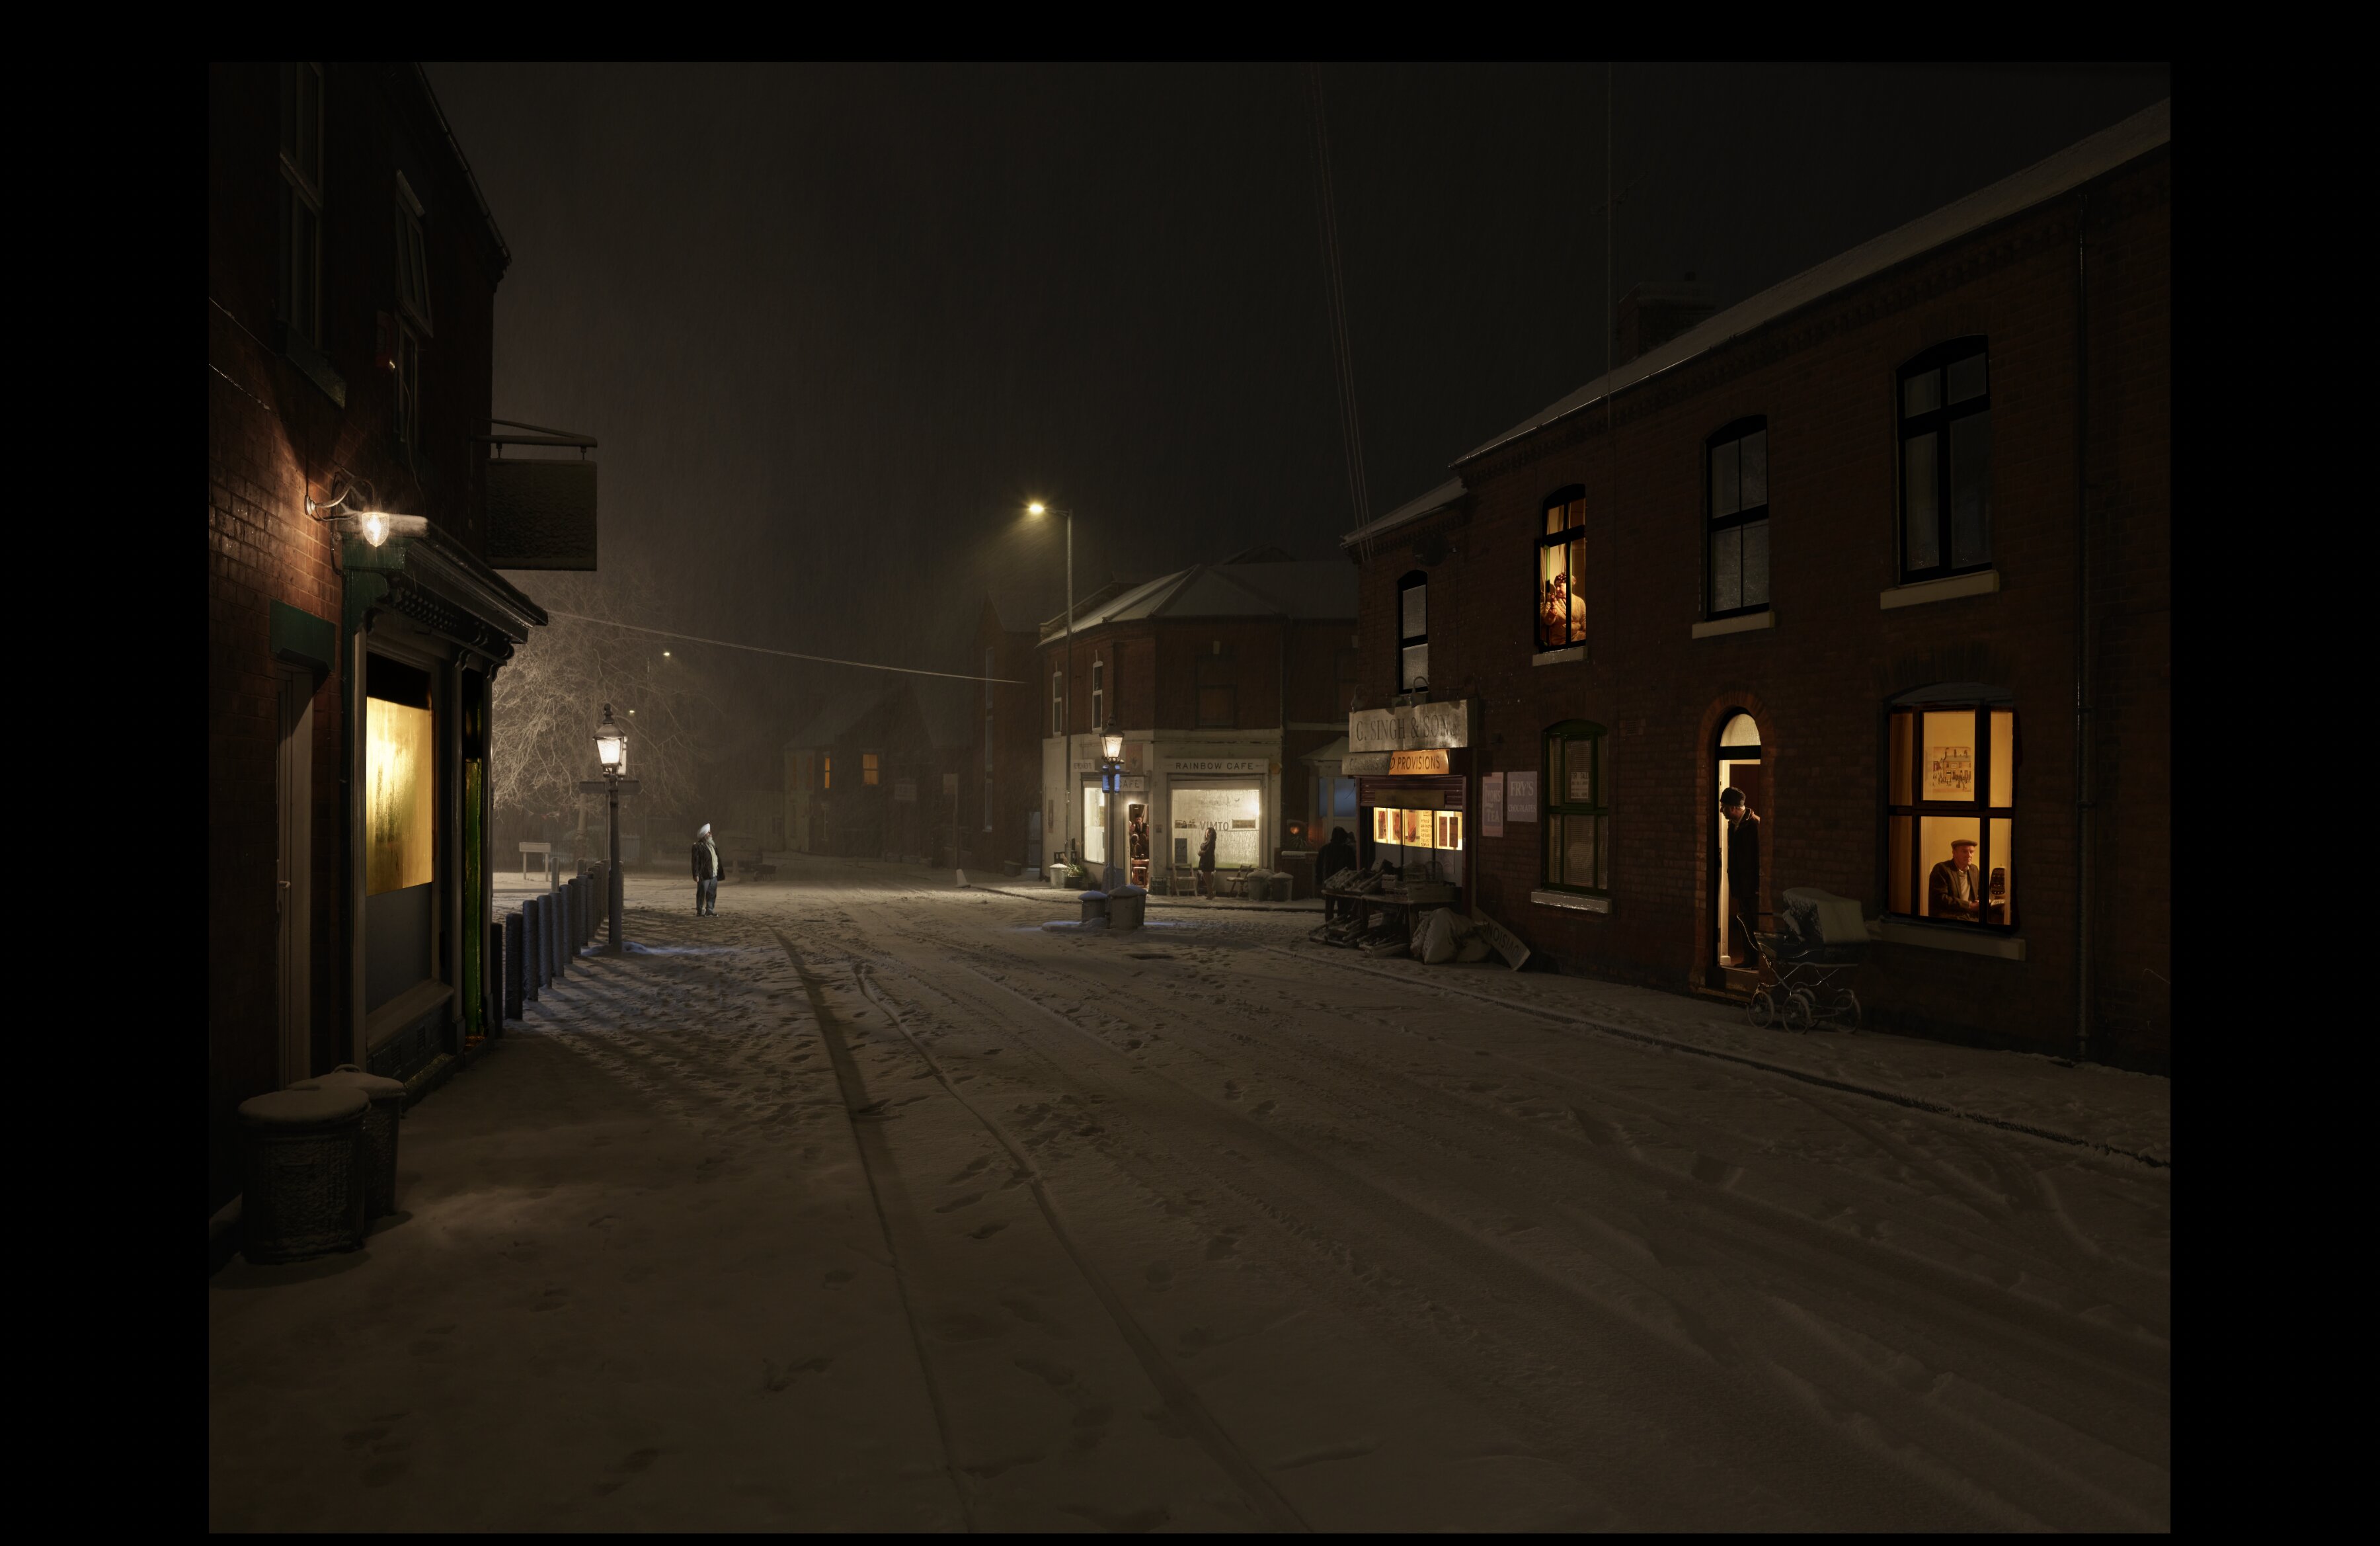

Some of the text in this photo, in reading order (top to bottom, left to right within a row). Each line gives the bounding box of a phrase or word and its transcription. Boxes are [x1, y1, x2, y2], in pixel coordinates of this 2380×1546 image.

[1370, 718, 1406, 741] SINGH
[1411, 717, 1419, 739] &
[1397, 755, 1441, 770] PROVISIONS
[1510, 781, 1534, 796] FRY'S
[1508, 803, 1537, 813] CHOCOLATES
[1486, 809, 1500, 822] TEA
[1199, 821, 1229, 831] VIMTO
